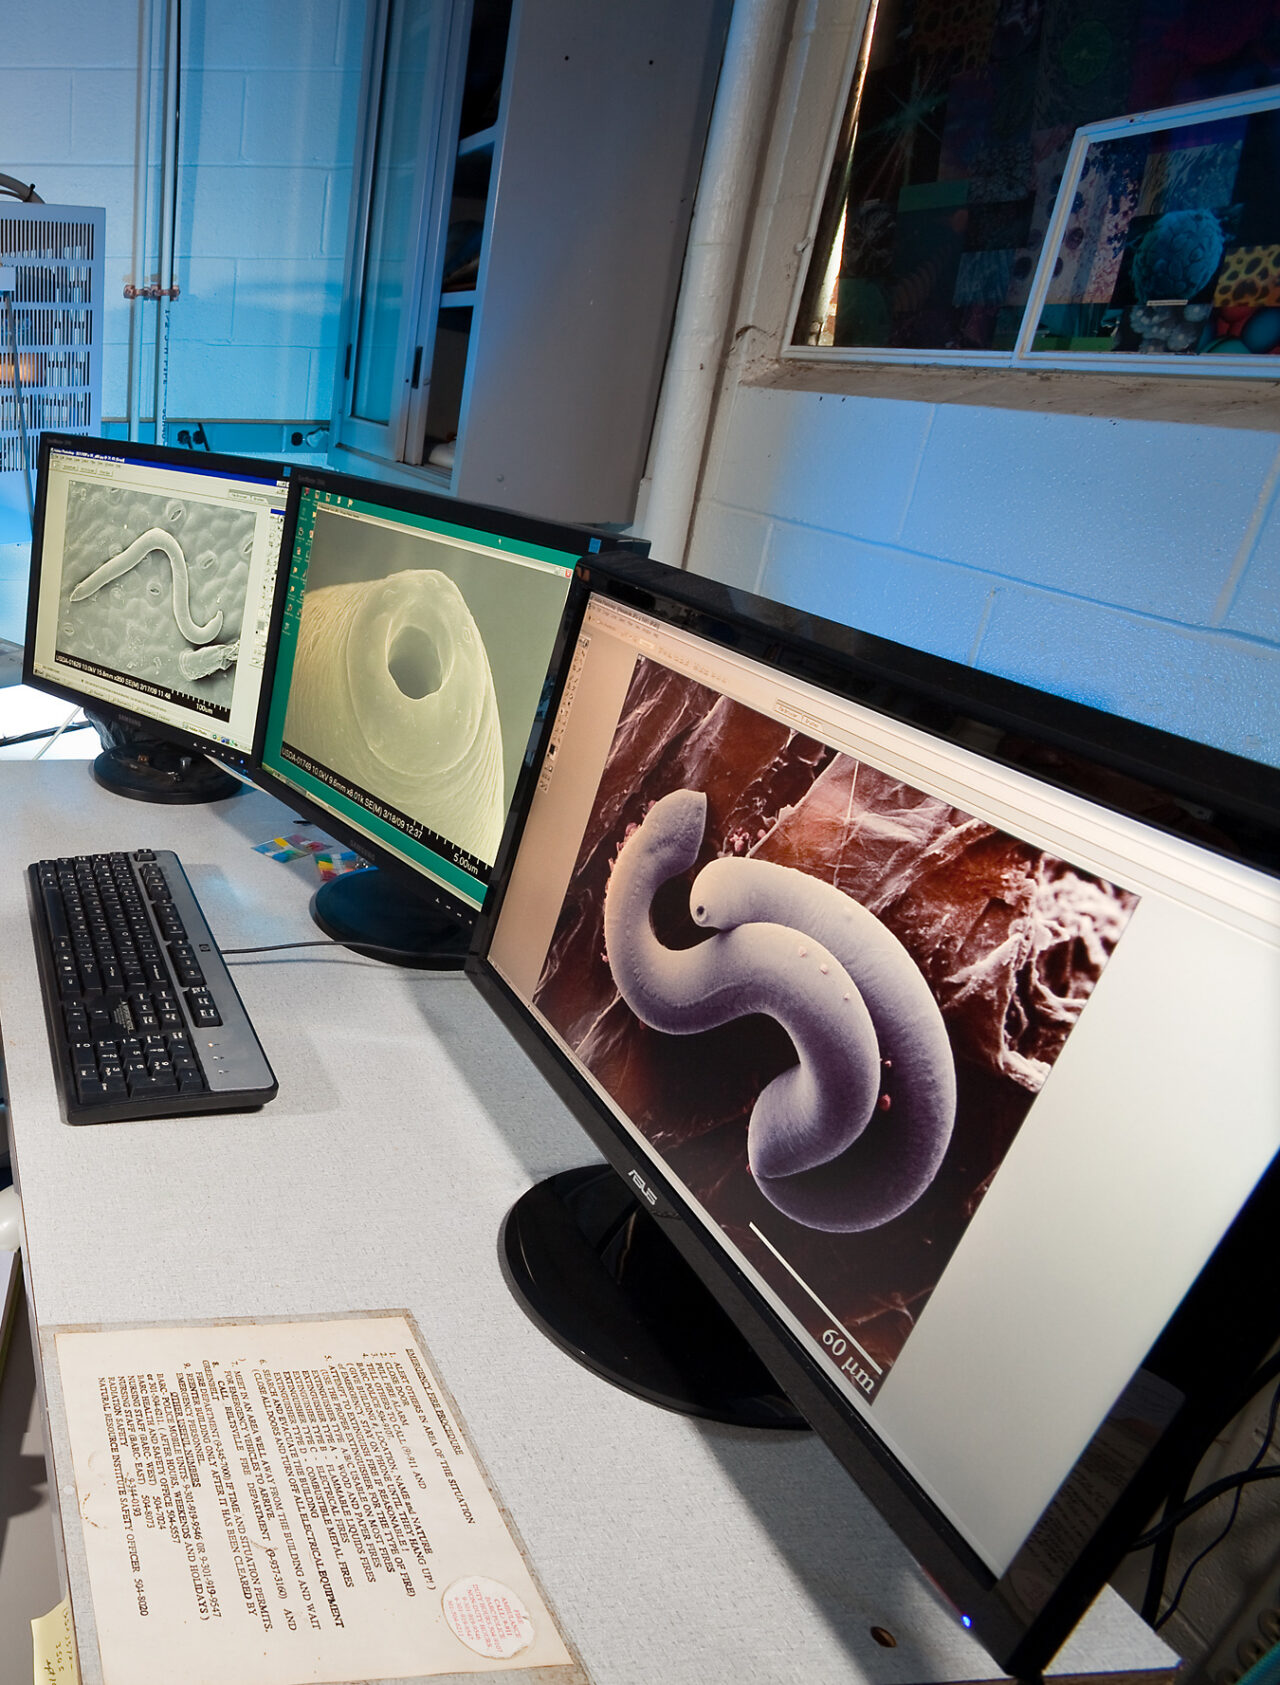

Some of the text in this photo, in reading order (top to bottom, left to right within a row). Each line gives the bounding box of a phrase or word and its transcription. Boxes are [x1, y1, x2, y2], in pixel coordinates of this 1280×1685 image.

[627, 1168, 658, 1207] ASUS
[822, 1328, 848, 1357] 60
[137, 1374, 147, 1394] BARC
[176, 1372, 193, 1417] EMERGENCY
[195, 1371, 205, 1386] FIRE
[202, 1359, 219, 1401] GREENBELT
[355, 1362, 369, 1381] BARC
[364, 1383, 380, 1407] POLICE
[374, 1362, 408, 1425] PULL FIRE ALARM
[383, 1361, 409, 1405] CLOSE DOOR
[405, 1348, 463, 1454] EMERGENCY FIRE PROCEDURE
[108, 1376, 121, 1415] RADIATION
[115, 1418, 127, 1447] SAFETY
[127, 1375, 140, 1406] NURSING
[134, 1409, 145, 1431] STAFF
[145, 1461, 157, 1485] WEST)
[141, 1396, 154, 1425] HEALTH
[200, 1388, 219, 1438] DEPARTMENT
[148, 1428, 158, 1444] AND
[152, 1445, 165, 1475] SAFETY
[170, 1391, 200, 1487] OTHER USEFUL NUMBERS
[224, 1370, 275, 1520] FOR EMERGENCY VEHICLES TO ARRIVE.
[262, 1369, 318, 1518] SEARCH AND EVACUATE THE BUILDING
[282, 1371, 306, 1422] EXTINGUISHER
[302, 1425, 314, 1444] TYPE
[316, 1465, 340, 1516] ELECTRICAL
[334, 1518, 349, 1543] FIRES
[328, 1365, 407, 1546] ATTEMPT TO EXTINGUISH FIRE IF REASONABLE
[393, 1362, 475, 1523] ALERT OTHERS IN AREA OF THE SITUATION
[98, 1377, 110, 1411] NATURAL
[104, 1413, 118, 1452] RESOURCE
[112, 1454, 126, 1495] INSTITUTE
[119, 1497, 132, 1531] SAFETY
[126, 1533, 140, 1572] OFFICER
[159, 1477, 172, 1507] OFFICE
[162, 1396, 174, 1422] POLICE
[168, 1425, 181, 1453] MOBILE
[196, 1542, 205, 1553] OR
[225, 1482, 234, 1490] IF
[273, 1372, 296, 1423] EXTINGUISHER
[291, 1425, 304, 1445] TYPE
[305, 1466, 332, 1525] COMBUSTIBLE
[326, 1527, 344, 1559] METAL
[338, 1561, 354, 1587] FIRES
[292, 1370, 316, 1422] EXTINGUISHER
[311, 1425, 324, 1444] TYPE
[326, 1464, 351, 1516] FLAMMABLE
[345, 1518, 365, 1554] LIQUIDS
[359, 1556, 376, 1582] FIRES
[217, 1380, 228, 1399] CALL
[224, 1406, 243, 1450] BELTSVILLE
[239, 1457, 251, 1475] FIRE
[247, 1482, 270, 1541] DEPARTMENT
[283, 1608, 297, 1630] AND
[227, 1491, 240, 1513] TIME
[234, 1514, 246, 1534] AND
[239, 1535, 260, 1584] SITUATION
[254, 1587, 273, 1632] PERMITS.
